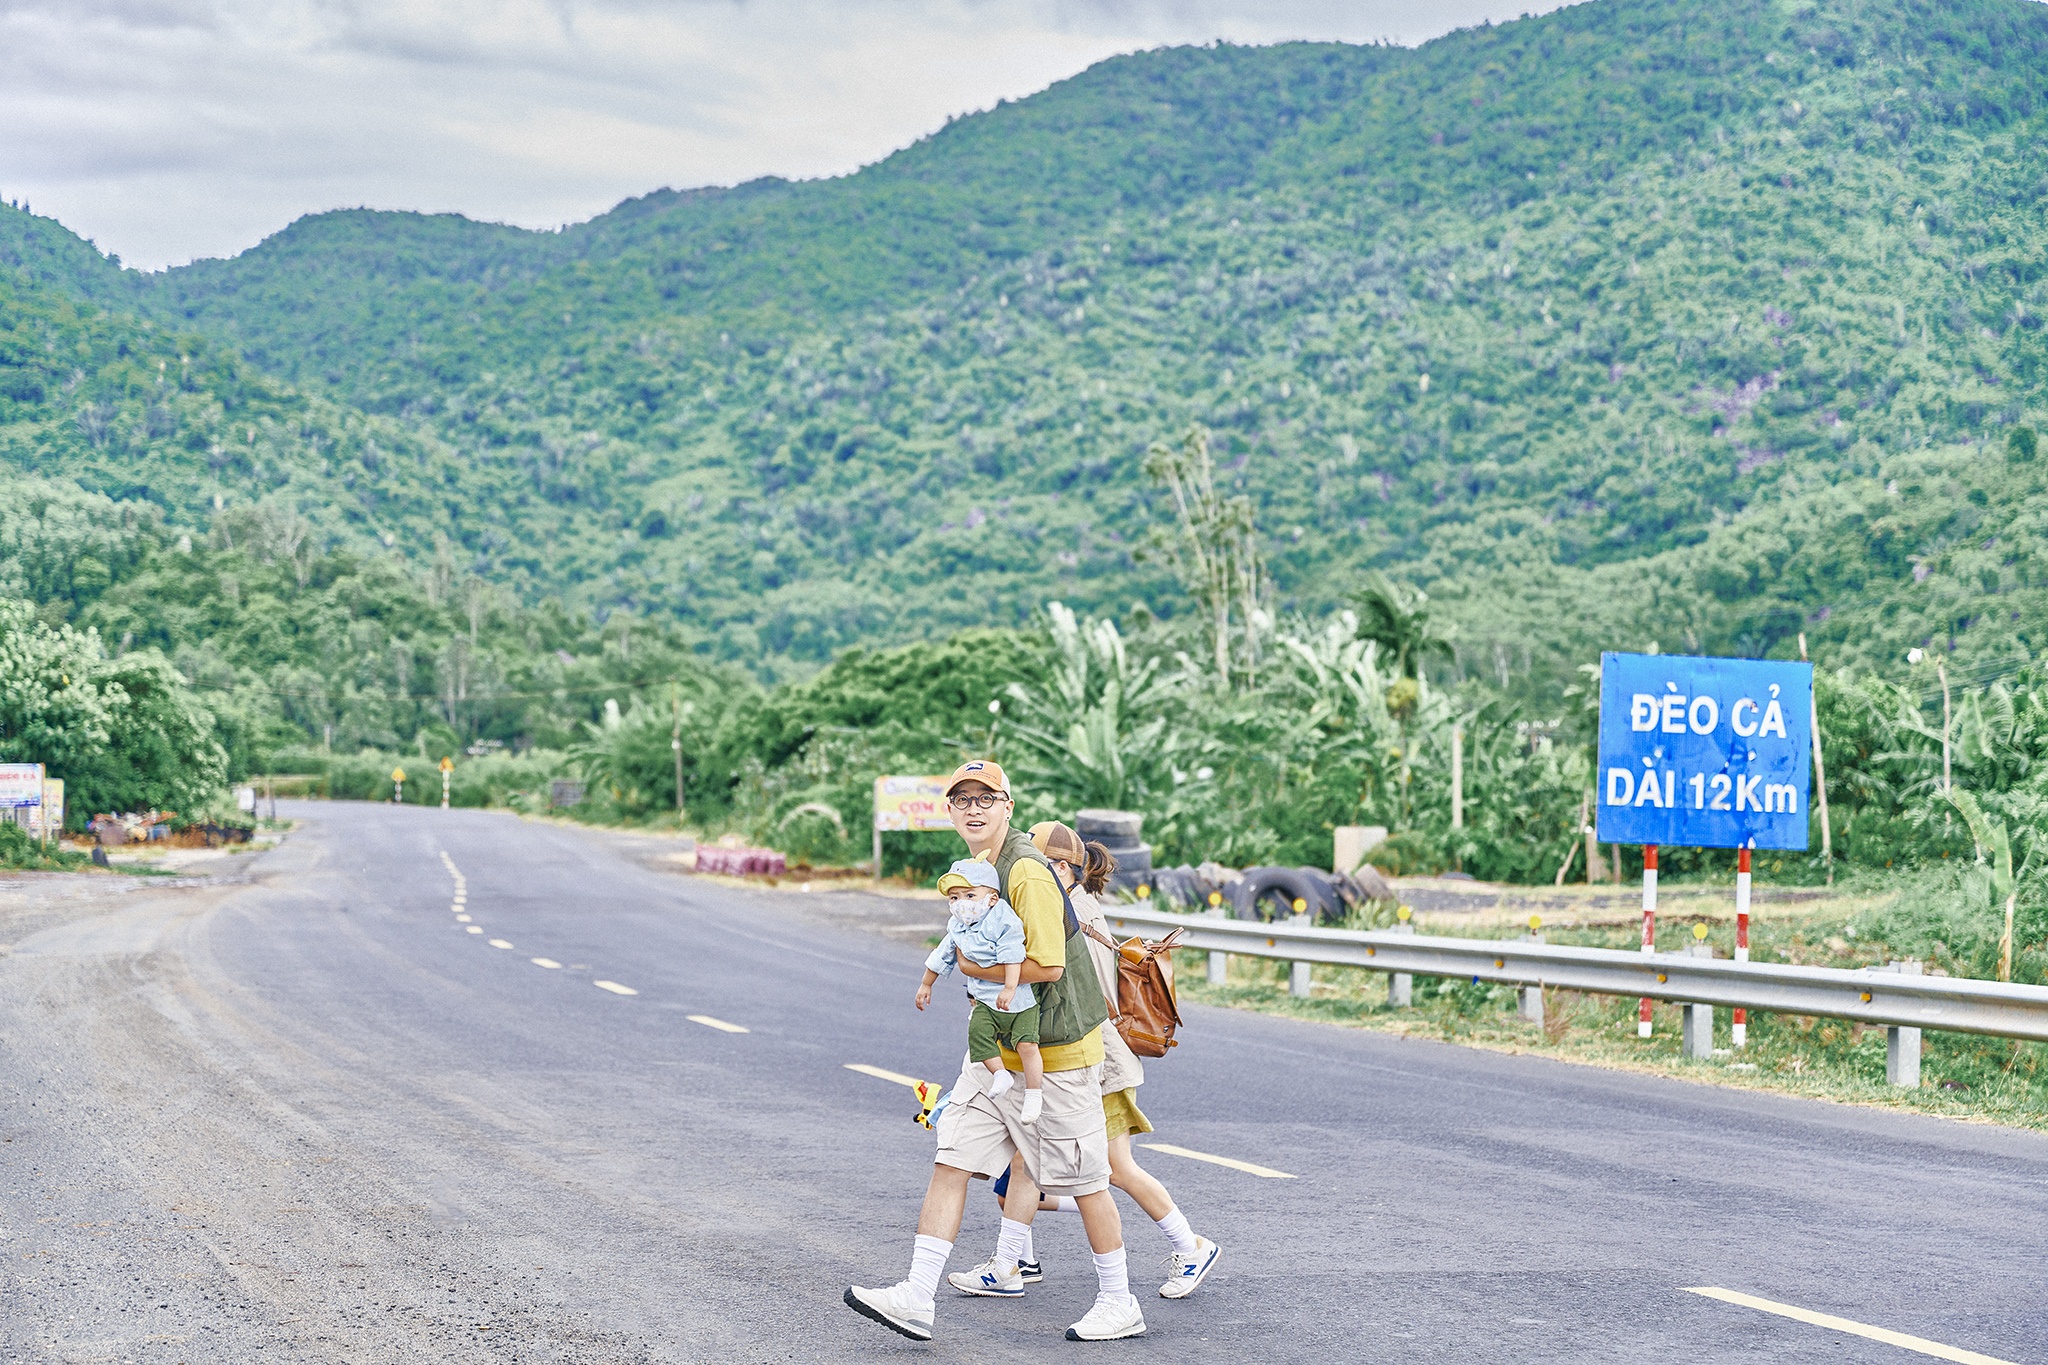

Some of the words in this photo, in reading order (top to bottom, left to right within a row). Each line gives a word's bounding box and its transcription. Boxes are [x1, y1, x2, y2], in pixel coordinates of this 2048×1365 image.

[1631, 681, 1719, 735] ĐÈO
[1731, 683, 1787, 739] CẢ
[1606, 756, 1676, 808] DÀI
[980, 1272, 997, 1287] N
[1182, 1264, 1197, 1276] N
